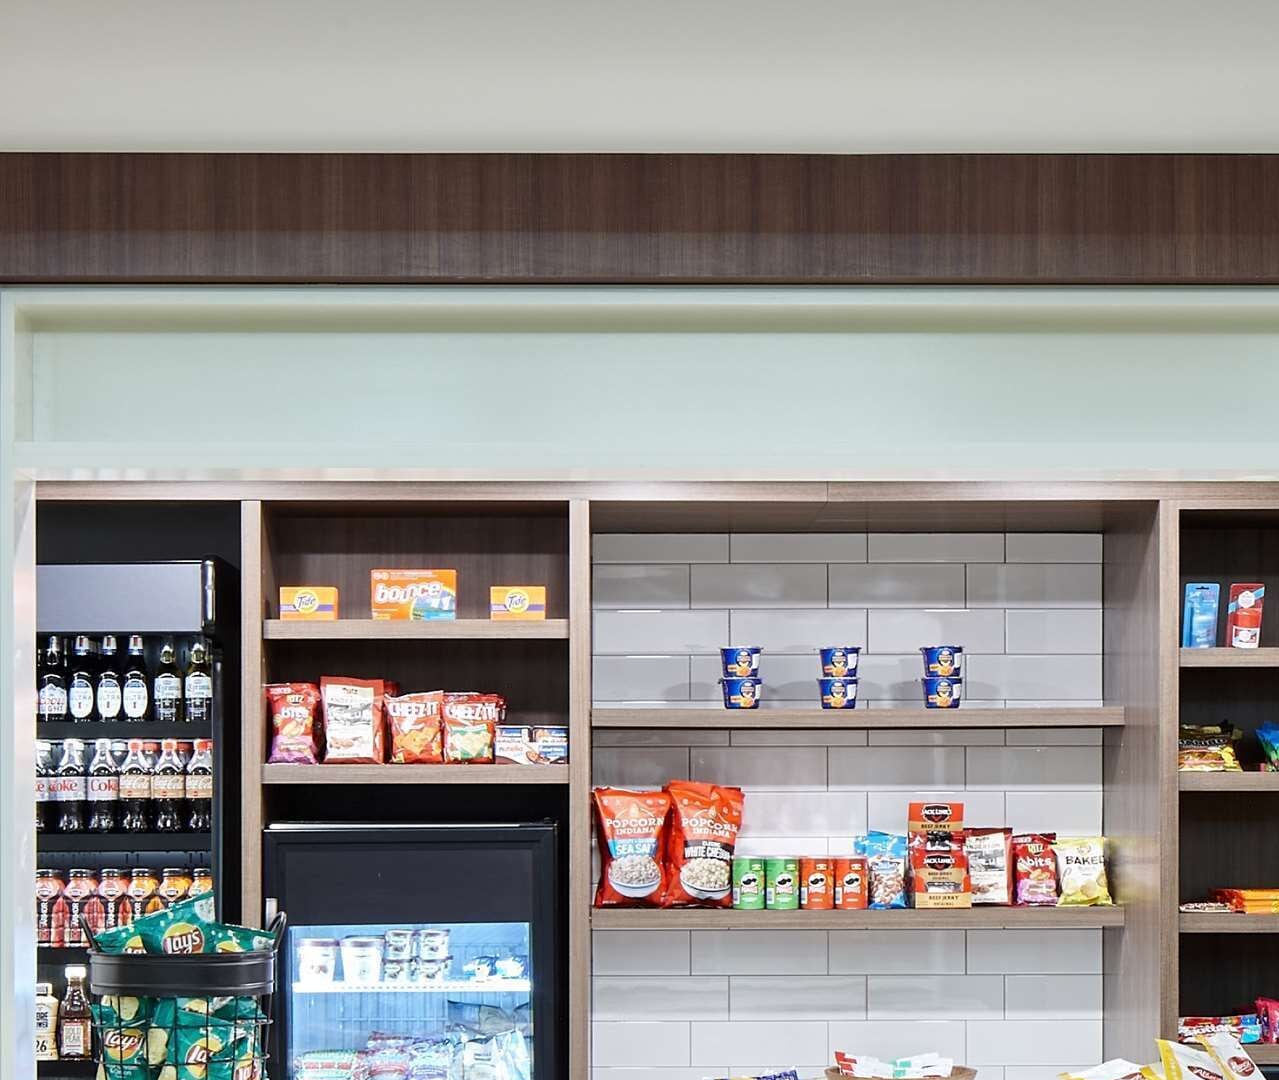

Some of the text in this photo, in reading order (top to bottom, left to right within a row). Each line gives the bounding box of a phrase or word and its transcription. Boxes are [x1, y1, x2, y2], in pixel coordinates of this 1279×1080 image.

[606, 818, 664, 828] POPCORN
[682, 818, 738, 833] POPCORN
[693, 828, 731, 837] INDIANA
[617, 844, 635, 855] SEA
